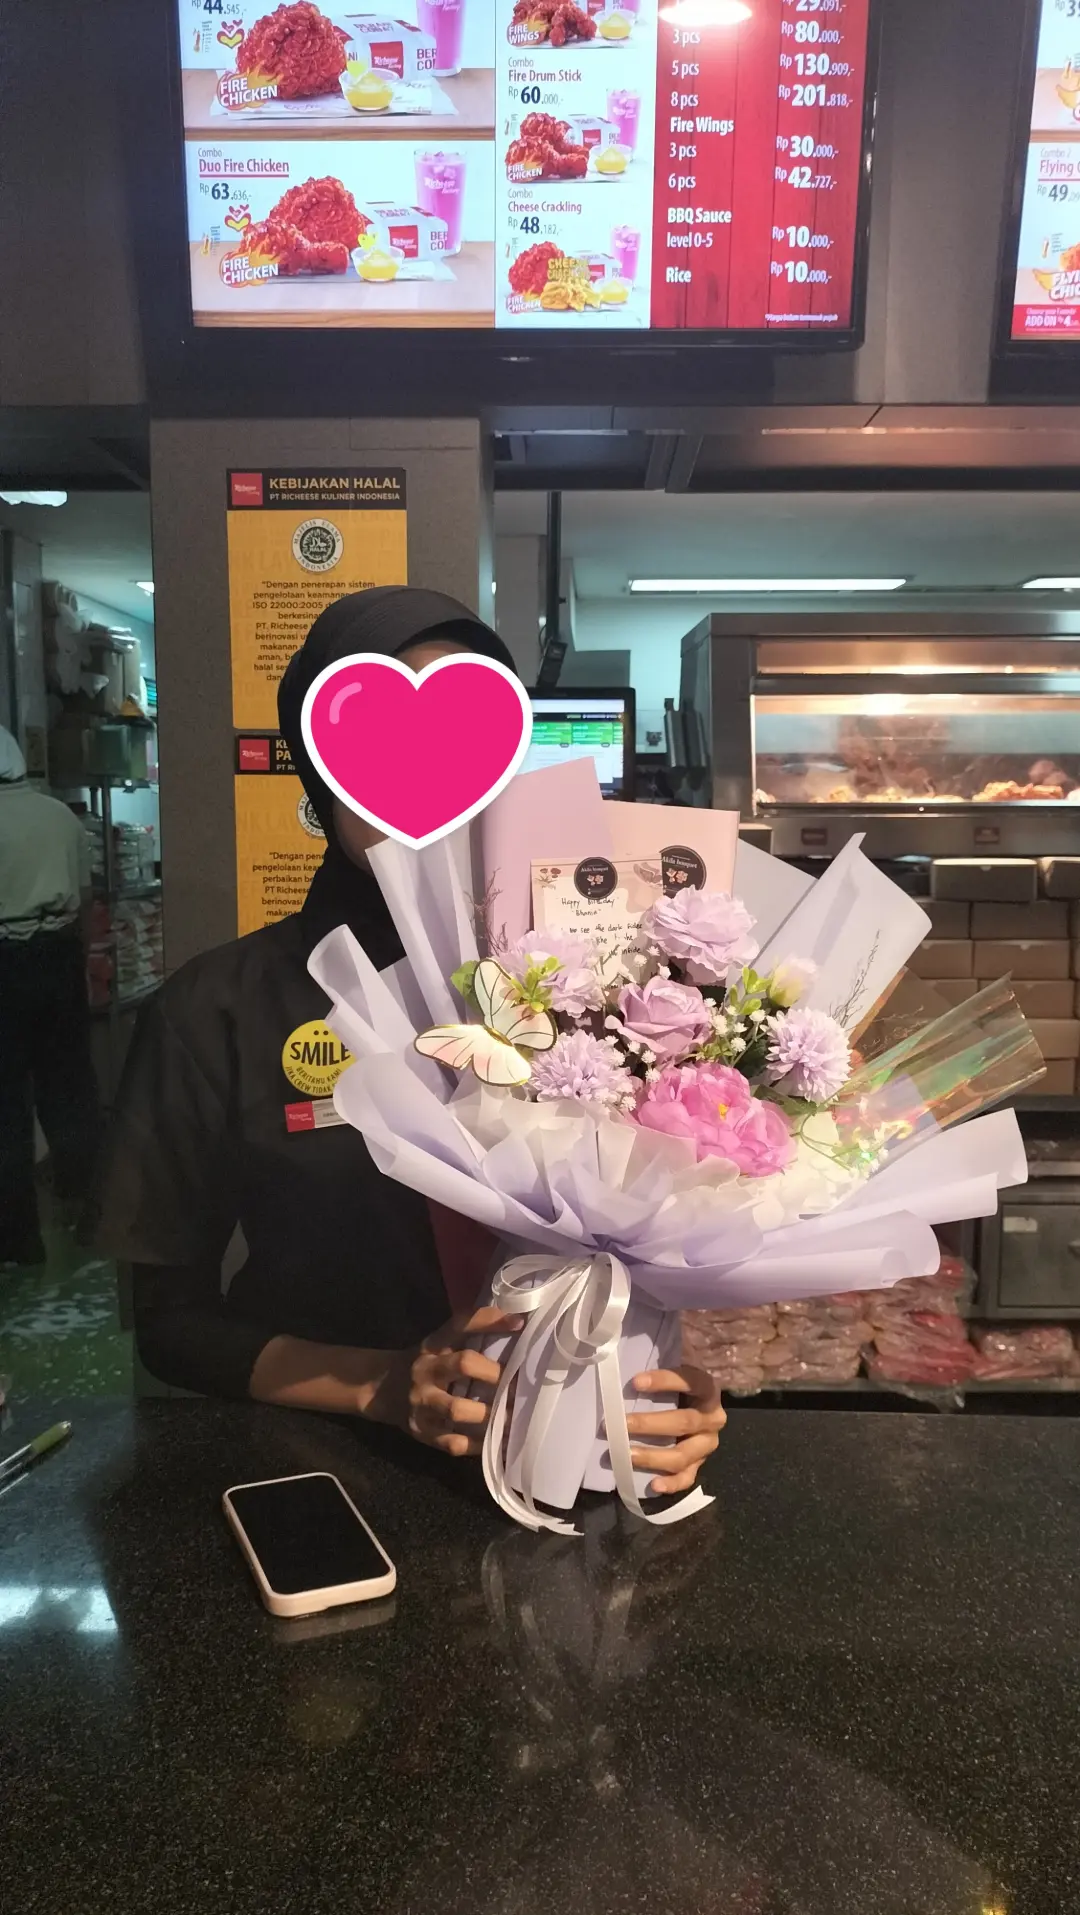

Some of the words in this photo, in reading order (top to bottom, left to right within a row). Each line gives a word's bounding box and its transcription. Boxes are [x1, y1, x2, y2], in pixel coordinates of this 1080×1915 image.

[509, 24, 528, 35] FIRE
[781, 21, 794, 37] Rp
[509, 31, 540, 45] WINGS
[673, 29, 680, 44] 3
[682, 32, 700, 48] pcs
[508, 57, 534, 67] Combo
[780, 53, 792, 70] Rp
[508, 70, 527, 82] Fire
[529, 70, 556, 82] Drum
[558, 69, 582, 82] Stick
[672, 60, 679, 76] 5
[681, 63, 700, 79] pcs
[220, 78, 248, 94] FIRE
[508, 86, 519, 99] Rp
[778, 84, 791, 100] Rp
[220, 85, 278, 107] CHICKEN
[671, 91, 678, 107] 8
[680, 94, 699, 110] pcs
[670, 117, 694, 133] Fire
[696, 117, 734, 136] Wings
[776, 136, 788, 152] Rp
[198, 147, 222, 158] Combo
[669, 142, 677, 158] 3
[679, 145, 697, 161] pcs
[199, 159, 222, 173] Duo
[223, 159, 244, 173] Fire
[246, 159, 289, 173] Chicken
[1040, 160, 1074, 177] Flying
[508, 168, 543, 181] CHICKEN
[774, 166, 787, 182] Rp
[200, 183, 209, 196] Rp
[668, 173, 676, 188] 6
[677, 176, 696, 192] pcs
[508, 188, 533, 199] Combo
[508, 201, 539, 212] Cheese
[541, 201, 582, 214] Crackling
[508, 216, 518, 230] Rp
[667, 207, 694, 225] BBQ
[695, 207, 732, 224] Sauce
[667, 232, 692, 248] level
[693, 232, 713, 248] 0-5
[772, 226, 784, 242] Rp
[223, 257, 249, 273] FIRE
[770, 261, 783, 277] Rp
[223, 263, 279, 284] CHICKEN
[665, 267, 692, 283] Rice
[269, 478, 349, 489] KEBIJAKAN
[354, 477, 400, 489] HALAL
[301, 582, 346, 591] penerapan
[253, 592, 304, 600] pengelolaan
[270, 622, 308, 630] Richeese
[266, 673, 281, 681] dan
[252, 864, 301, 873] pengelolaan
[262, 875, 303, 884] perbaikan
[265, 886, 275, 894] PT
[262, 897, 303, 905] berinovasi
[561, 897, 580, 909] Happy
[296, 1066, 326, 1085] BERITAHU
[294, 1078, 312, 1092] CREW
